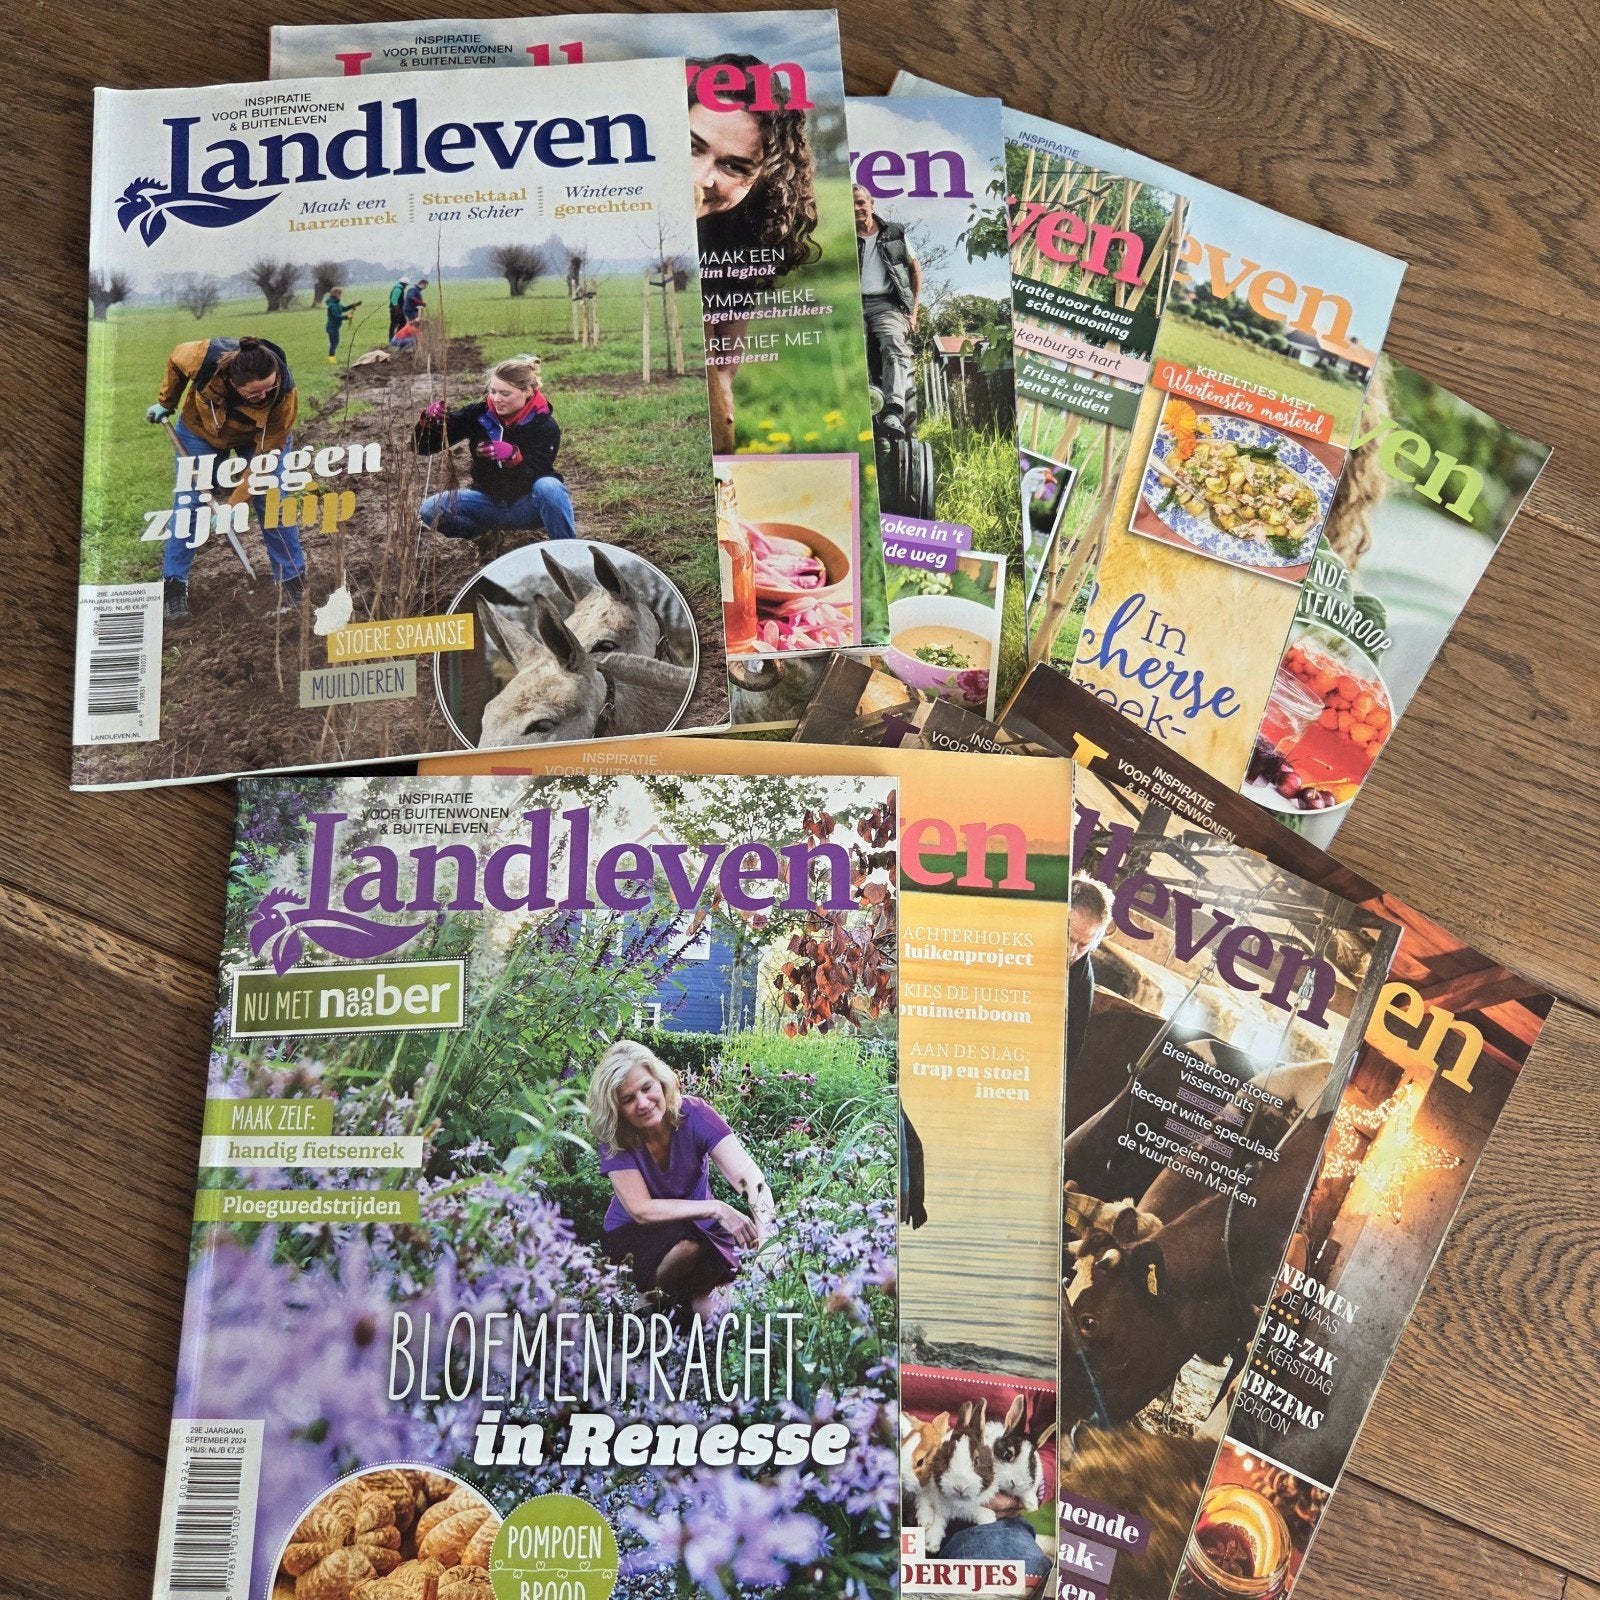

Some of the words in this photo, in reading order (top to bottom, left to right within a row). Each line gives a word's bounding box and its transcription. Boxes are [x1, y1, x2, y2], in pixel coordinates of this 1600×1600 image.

[382, 46, 418, 57] VOOR
[421, 44, 513, 56] BUITENWONEN
[415, 34, 482, 45] INSPIRATIE
[400, 58, 408, 67] &
[411, 56, 496, 67] BUITENLEVEN
[245, 93, 312, 107] INSPIRATIE
[212, 111, 248, 122] VOOR
[251, 103, 345, 117] BUITENWONEN
[229, 122, 238, 131] &
[242, 115, 327, 130] BUITENLEVEN
[162, 97, 656, 197] Landleven
[1018, 131, 1081, 159] INSPIRATIE
[422, 187, 528, 206] Streektaal
[565, 183, 644, 199] Winterse
[299, 199, 350, 215] Maak
[356, 198, 387, 210] een
[428, 208, 462, 222] van
[467, 205, 524, 220] Schier
[554, 200, 653, 220] gerechten
[288, 211, 399, 232] laarzenrek
[750, 247, 785, 262] EEN
[726, 264, 776, 279] leghok
[702, 288, 816, 309] YMPATHIEKE
[1011, 280, 1055, 301] iratie
[1056, 294, 1091, 313] voor
[1092, 304, 1134, 327] bouw
[1025, 298, 1130, 341] schuurwoning
[705, 333, 780, 352] REATIEF
[784, 330, 823, 347] MET
[1013, 328, 1086, 360] kenburgs
[1088, 351, 1121, 371] hart
[1023, 364, 1069, 390] Frisse,
[1072, 381, 1114, 401] verse
[1194, 364, 1278, 402] KRIELTJES
[1280, 392, 1316, 413] MET
[1052, 387, 1111, 415] kruiden
[1162, 365, 1254, 414] Wartenster
[1259, 403, 1324, 436] mosterd
[173, 442, 382, 496] Heggen
[140, 492, 250, 549] zijn
[264, 481, 357, 534] hip
[930, 526, 948, 542] in
[910, 549, 948, 569] weg
[110, 589, 147, 597] JAARGANG
[336, 626, 392, 656] STOERE
[396, 620, 466, 650] SPAANSE
[1141, 609, 1187, 656] In
[312, 667, 405, 700] MUILDIEREN
[91, 732, 142, 741] LANDLEVEN.NL
[582, 752, 658, 767] INSPIRATIE
[399, 793, 473, 805] INSPIRATIE
[1117, 759, 1152, 788] VOOR
[1151, 782, 1237, 843] BUITENWONEN
[1152, 766, 1216, 814] INSPIRATIE
[362, 809, 400, 820] VOOR
[405, 807, 509, 819] BUITENWONEN
[380, 825, 388, 835] &
[393, 823, 488, 835] BUITENLEVEN
[306, 806, 859, 913] Landleven
[903, 926, 1034, 947] ACHTERHOEKS
[904, 943, 1034, 967] luikenproject
[244, 992, 269, 1022] NU
[275, 990, 313, 1020] MET
[904, 984, 942, 998] KIES
[946, 986, 969, 1000] DE
[972, 988, 1032, 1005] JUISTE
[910, 1042, 949, 1057] AAN
[953, 1044, 976, 1059] DE
[980, 1046, 1030, 1062] SLAG:
[912, 1061, 953, 1080] trap
[956, 1065, 980, 1080] en
[983, 1065, 1030, 1081] stoel
[1162, 1041, 1239, 1088] Breipatroon
[1242, 1082, 1284, 1109] stoere
[975, 1083, 1030, 1101] ineen
[1180, 1069, 1255, 1113] vissersmuts
[231, 1105, 274, 1130] MAAK
[278, 1105, 316, 1131] ZELF:
[1131, 1081, 1182, 1115] Recept
[1179, 1106, 1213, 1130] witte
[1213, 1124, 1280, 1163] speculaas
[228, 1141, 298, 1163] handig
[302, 1141, 405, 1160] fietsenrek
[1135, 1122, 1208, 1167] Opgroeien
[1210, 1159, 1253, 1187] onder
[1118, 1133, 1136, 1151] de
[1139, 1145, 1203, 1182] vuurtoren
[1205, 1172, 1257, 1208] Marken
[222, 1196, 402, 1219] Ploegwedstrijden
[1281, 1289, 1301, 1311] DE
[1301, 1302, 1340, 1335] MAAS
[388, 1311, 804, 1403] BLOEMENPRACHT
[1268, 1345, 1334, 1396] KERSTDAG
[1236, 1392, 1291, 1435] SCHOON
[185, 1436, 229, 1444] SEPTEMBER
[190, 1426, 203, 1435] 29E
[204, 1427, 244, 1435] JAARGANG
[473, 1410, 543, 1466] in
[560, 1413, 851, 1467] Renesse
[185, 1446, 207, 1454] PRIJS:
[208, 1446, 226, 1454] NL/B
[178, 1460, 190, 1498] 00924
[230, 1509, 241, 1546] 031030
[507, 1525, 602, 1559] POMPOEN
[226, 1551, 238, 1589] 719831
